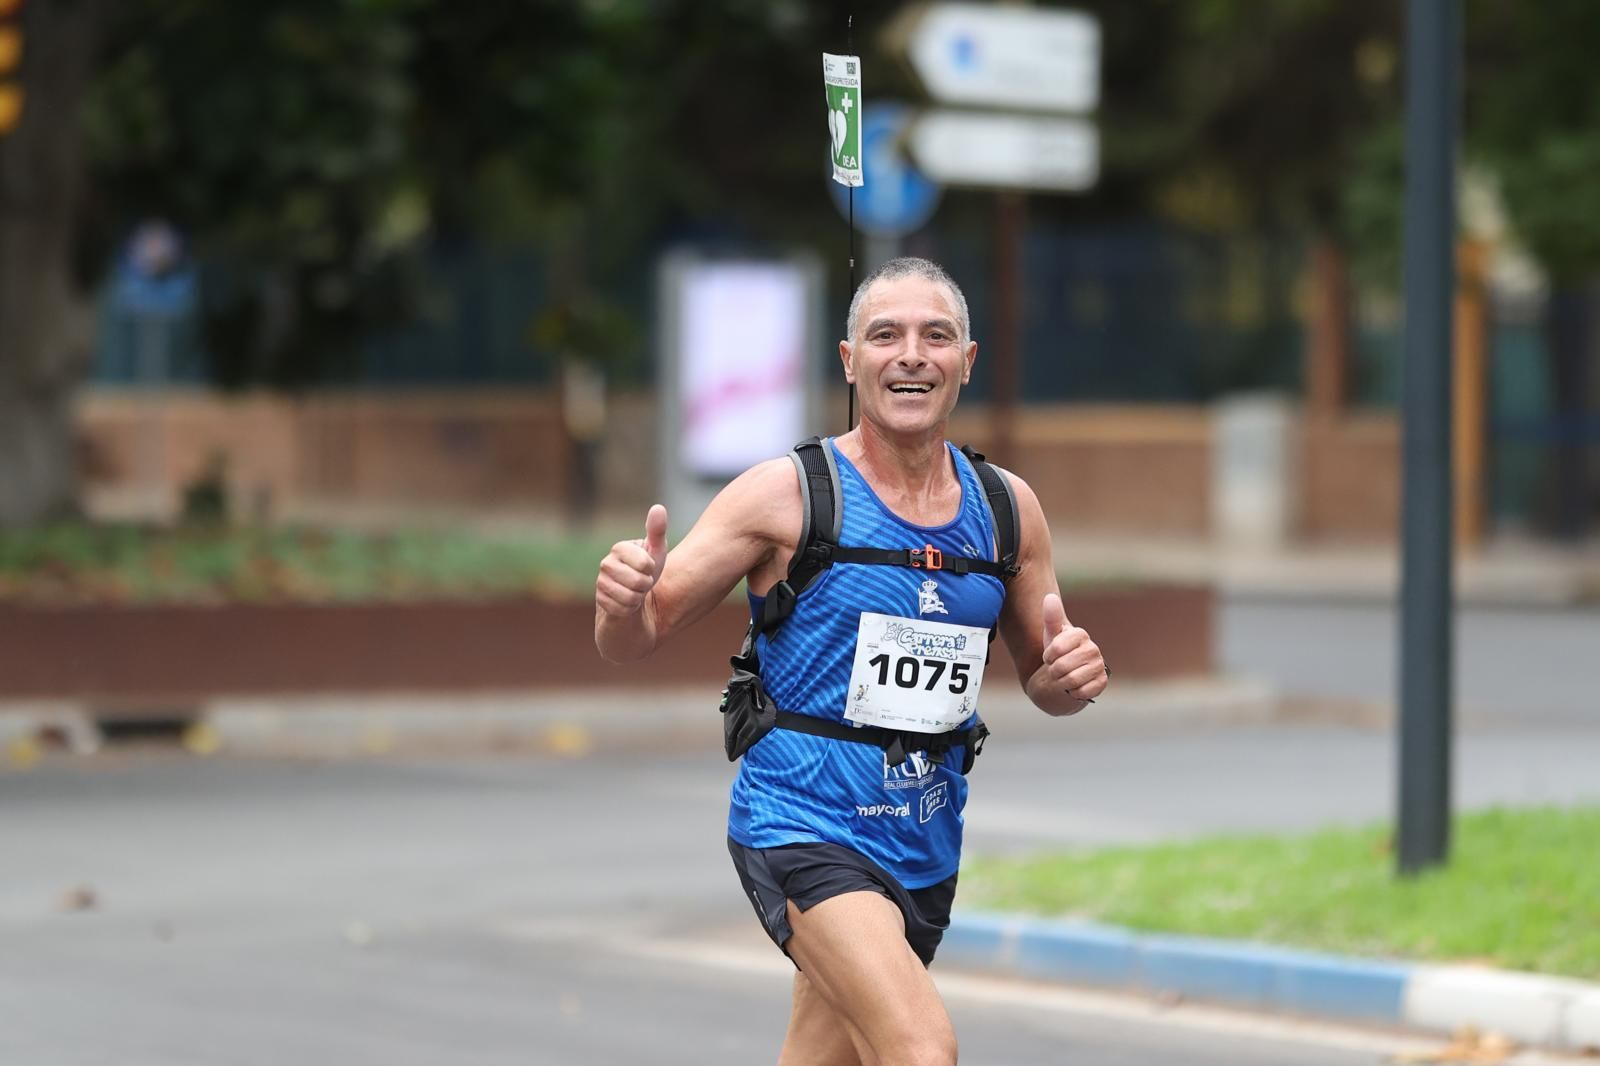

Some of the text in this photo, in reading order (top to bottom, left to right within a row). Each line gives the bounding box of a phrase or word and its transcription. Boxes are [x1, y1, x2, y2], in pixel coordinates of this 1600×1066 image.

[897, 627, 956, 649] Carrera
[910, 643, 957, 660] Prensa
[868, 653, 971, 695] 1075
[855, 801, 911, 817] mayoral
